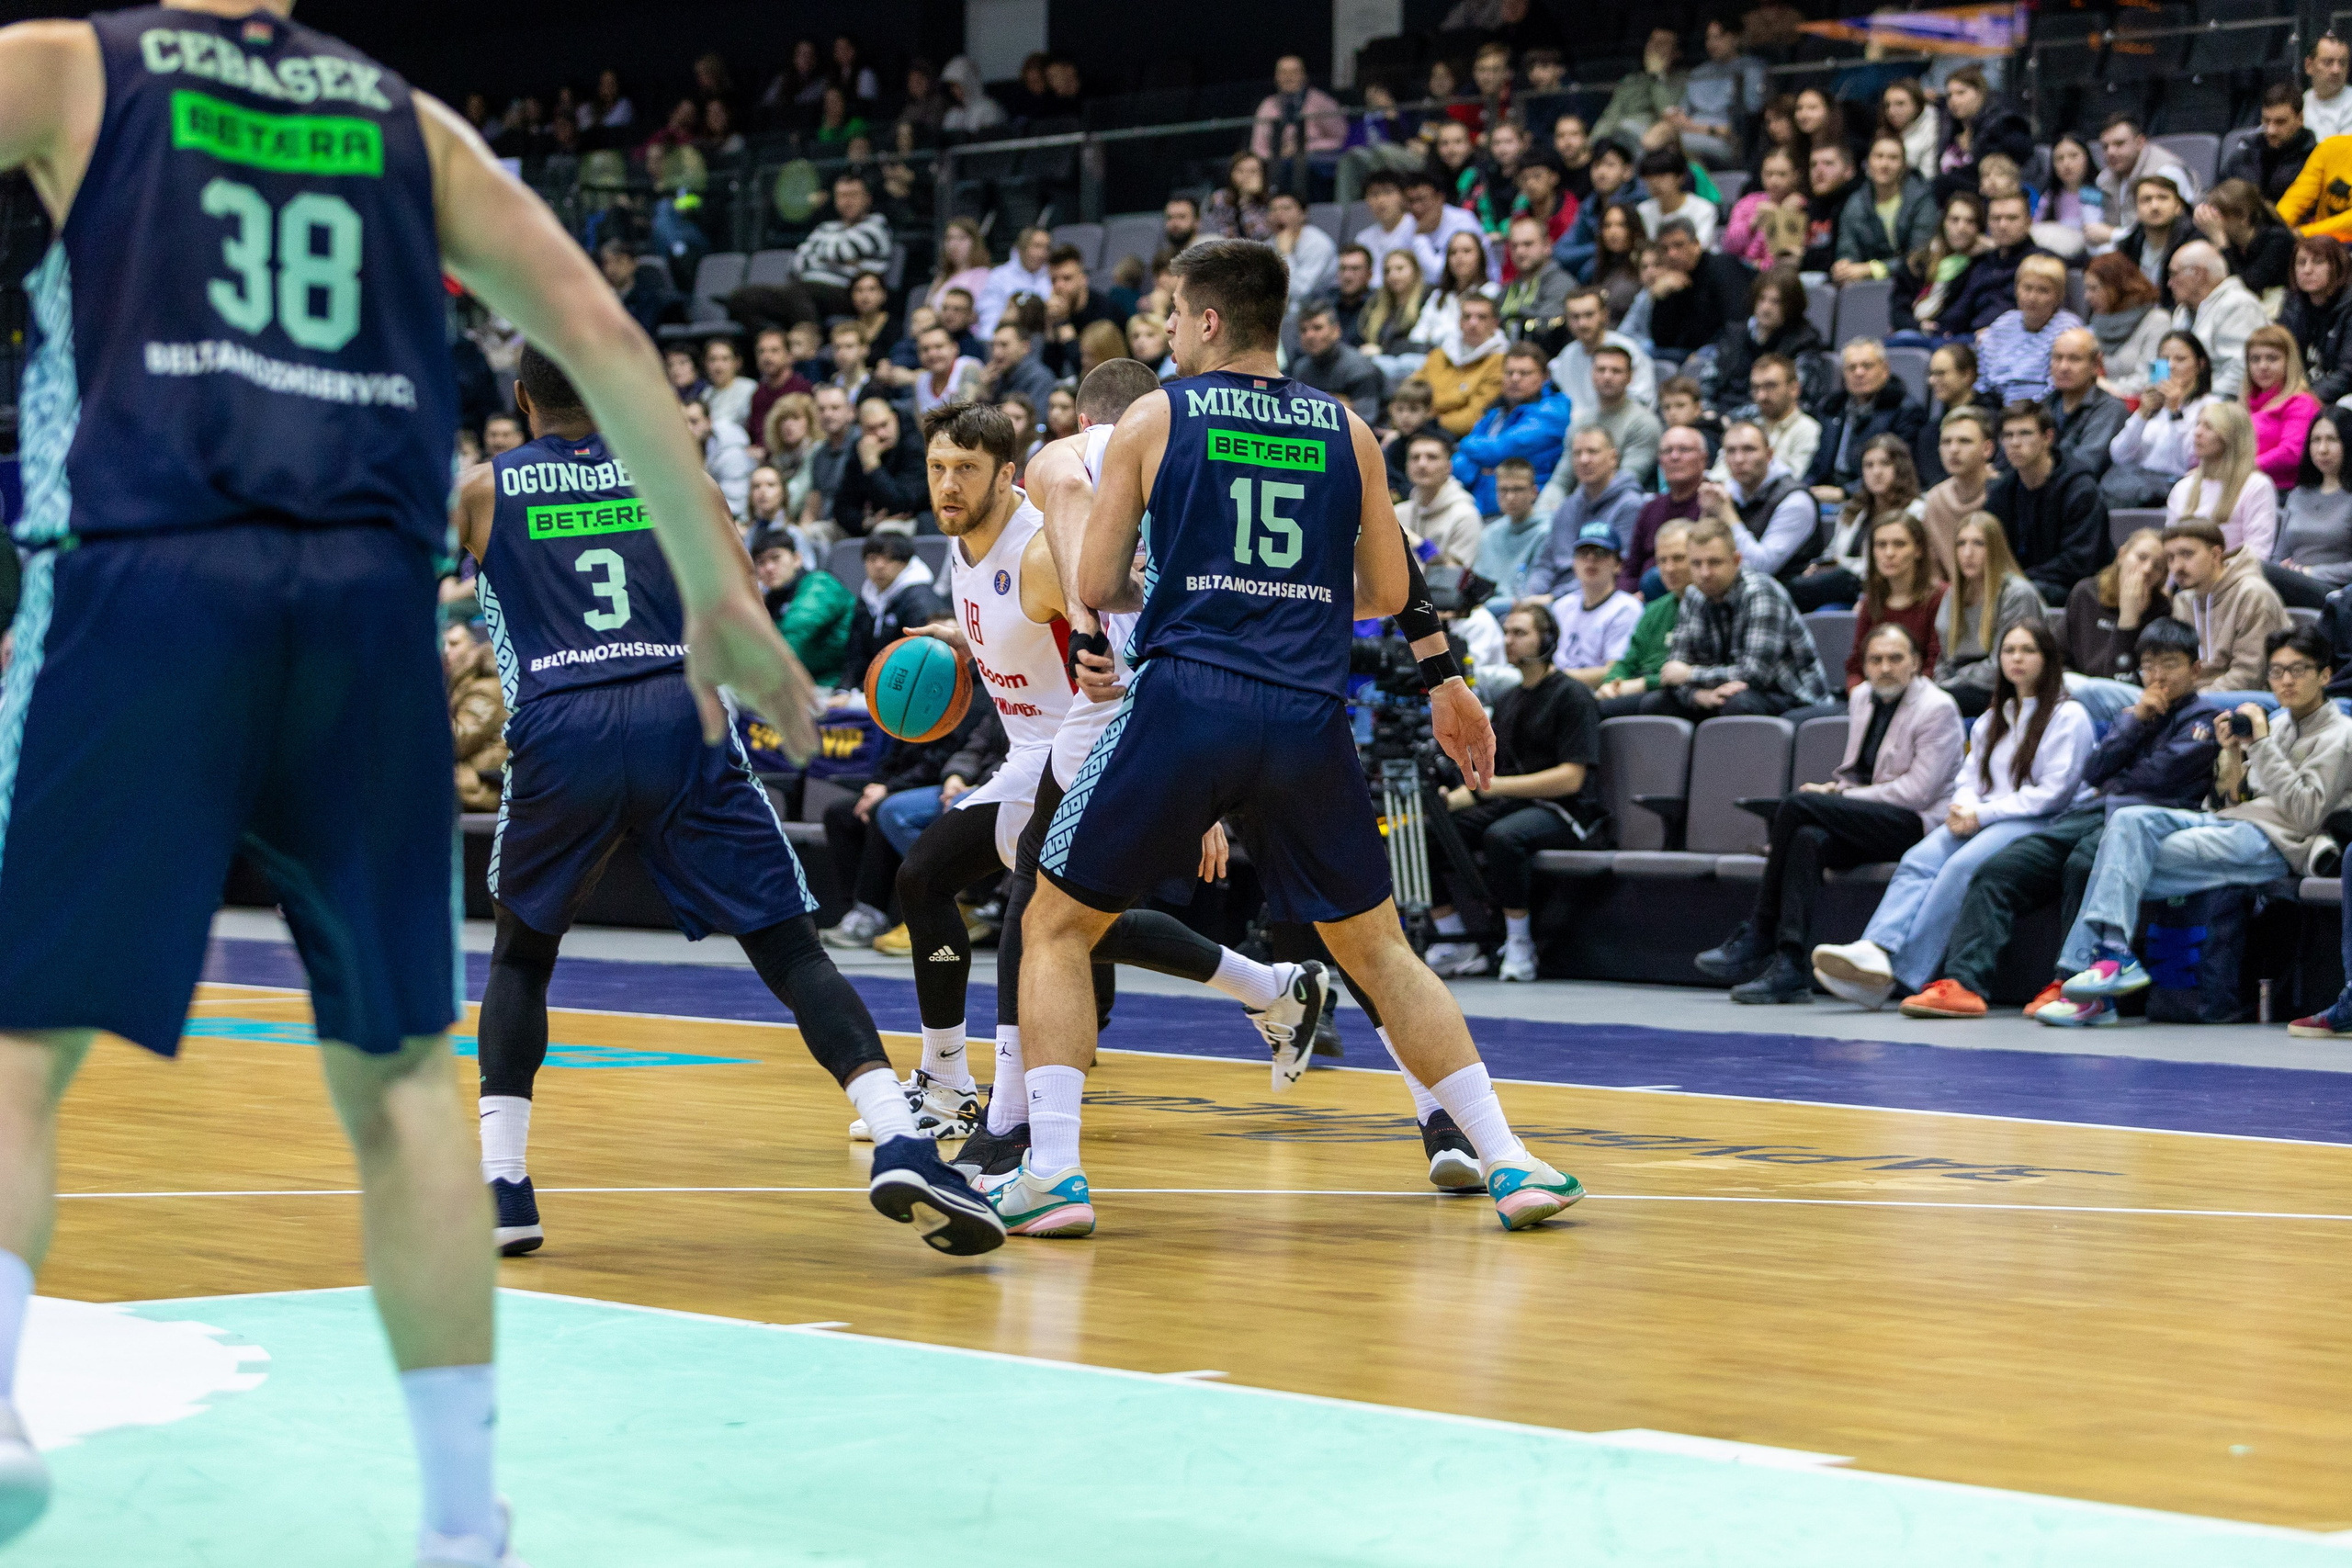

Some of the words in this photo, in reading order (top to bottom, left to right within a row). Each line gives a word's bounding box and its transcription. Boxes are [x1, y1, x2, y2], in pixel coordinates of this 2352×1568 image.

[200, 177, 363, 351] 38
[1185, 387, 1340, 431] MIKULSKI
[502, 458, 638, 496] OGUNGBE
[1229, 477, 1305, 569] 15
[574, 548, 631, 631] 3
[963, 598, 985, 646] 18
